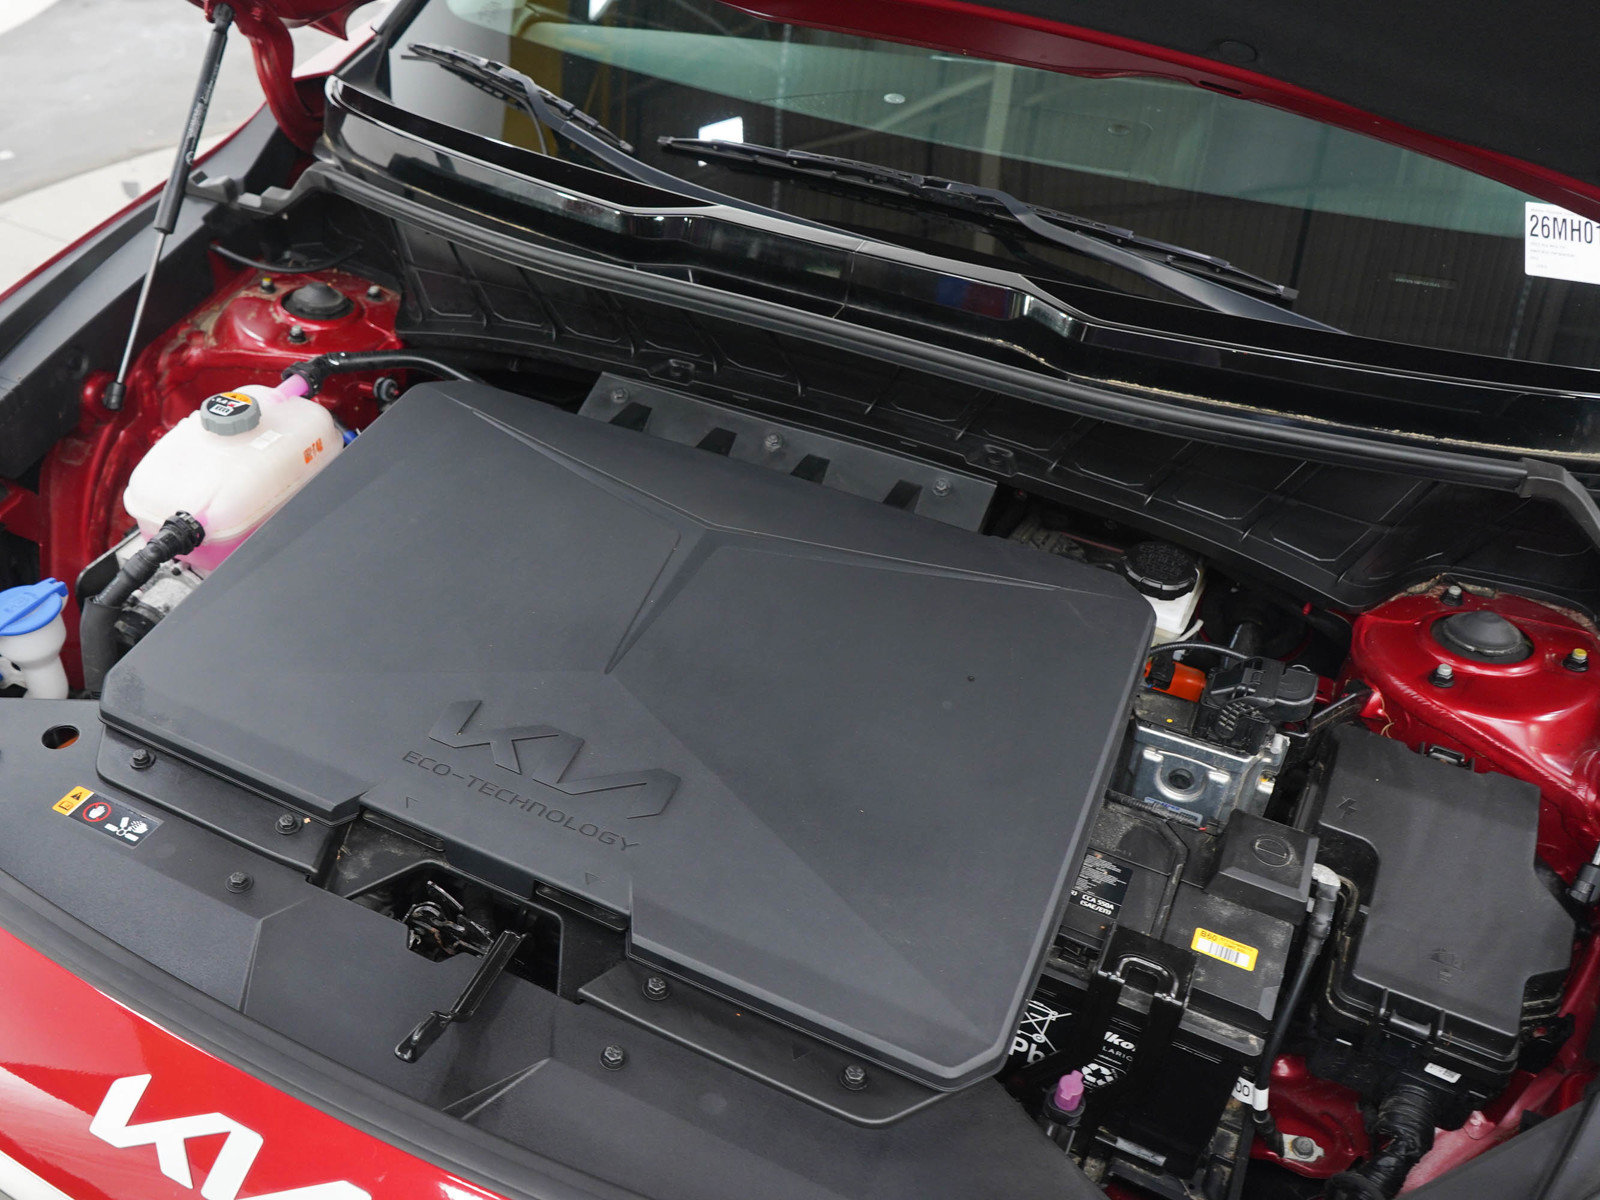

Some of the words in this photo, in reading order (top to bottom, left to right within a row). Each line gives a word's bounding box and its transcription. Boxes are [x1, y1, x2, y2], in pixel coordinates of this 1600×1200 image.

[402, 750, 640, 852] ECO-TECHNOLOGY
[428, 699, 682, 820] KIA
[1009, 1036, 1046, 1065] Pb
